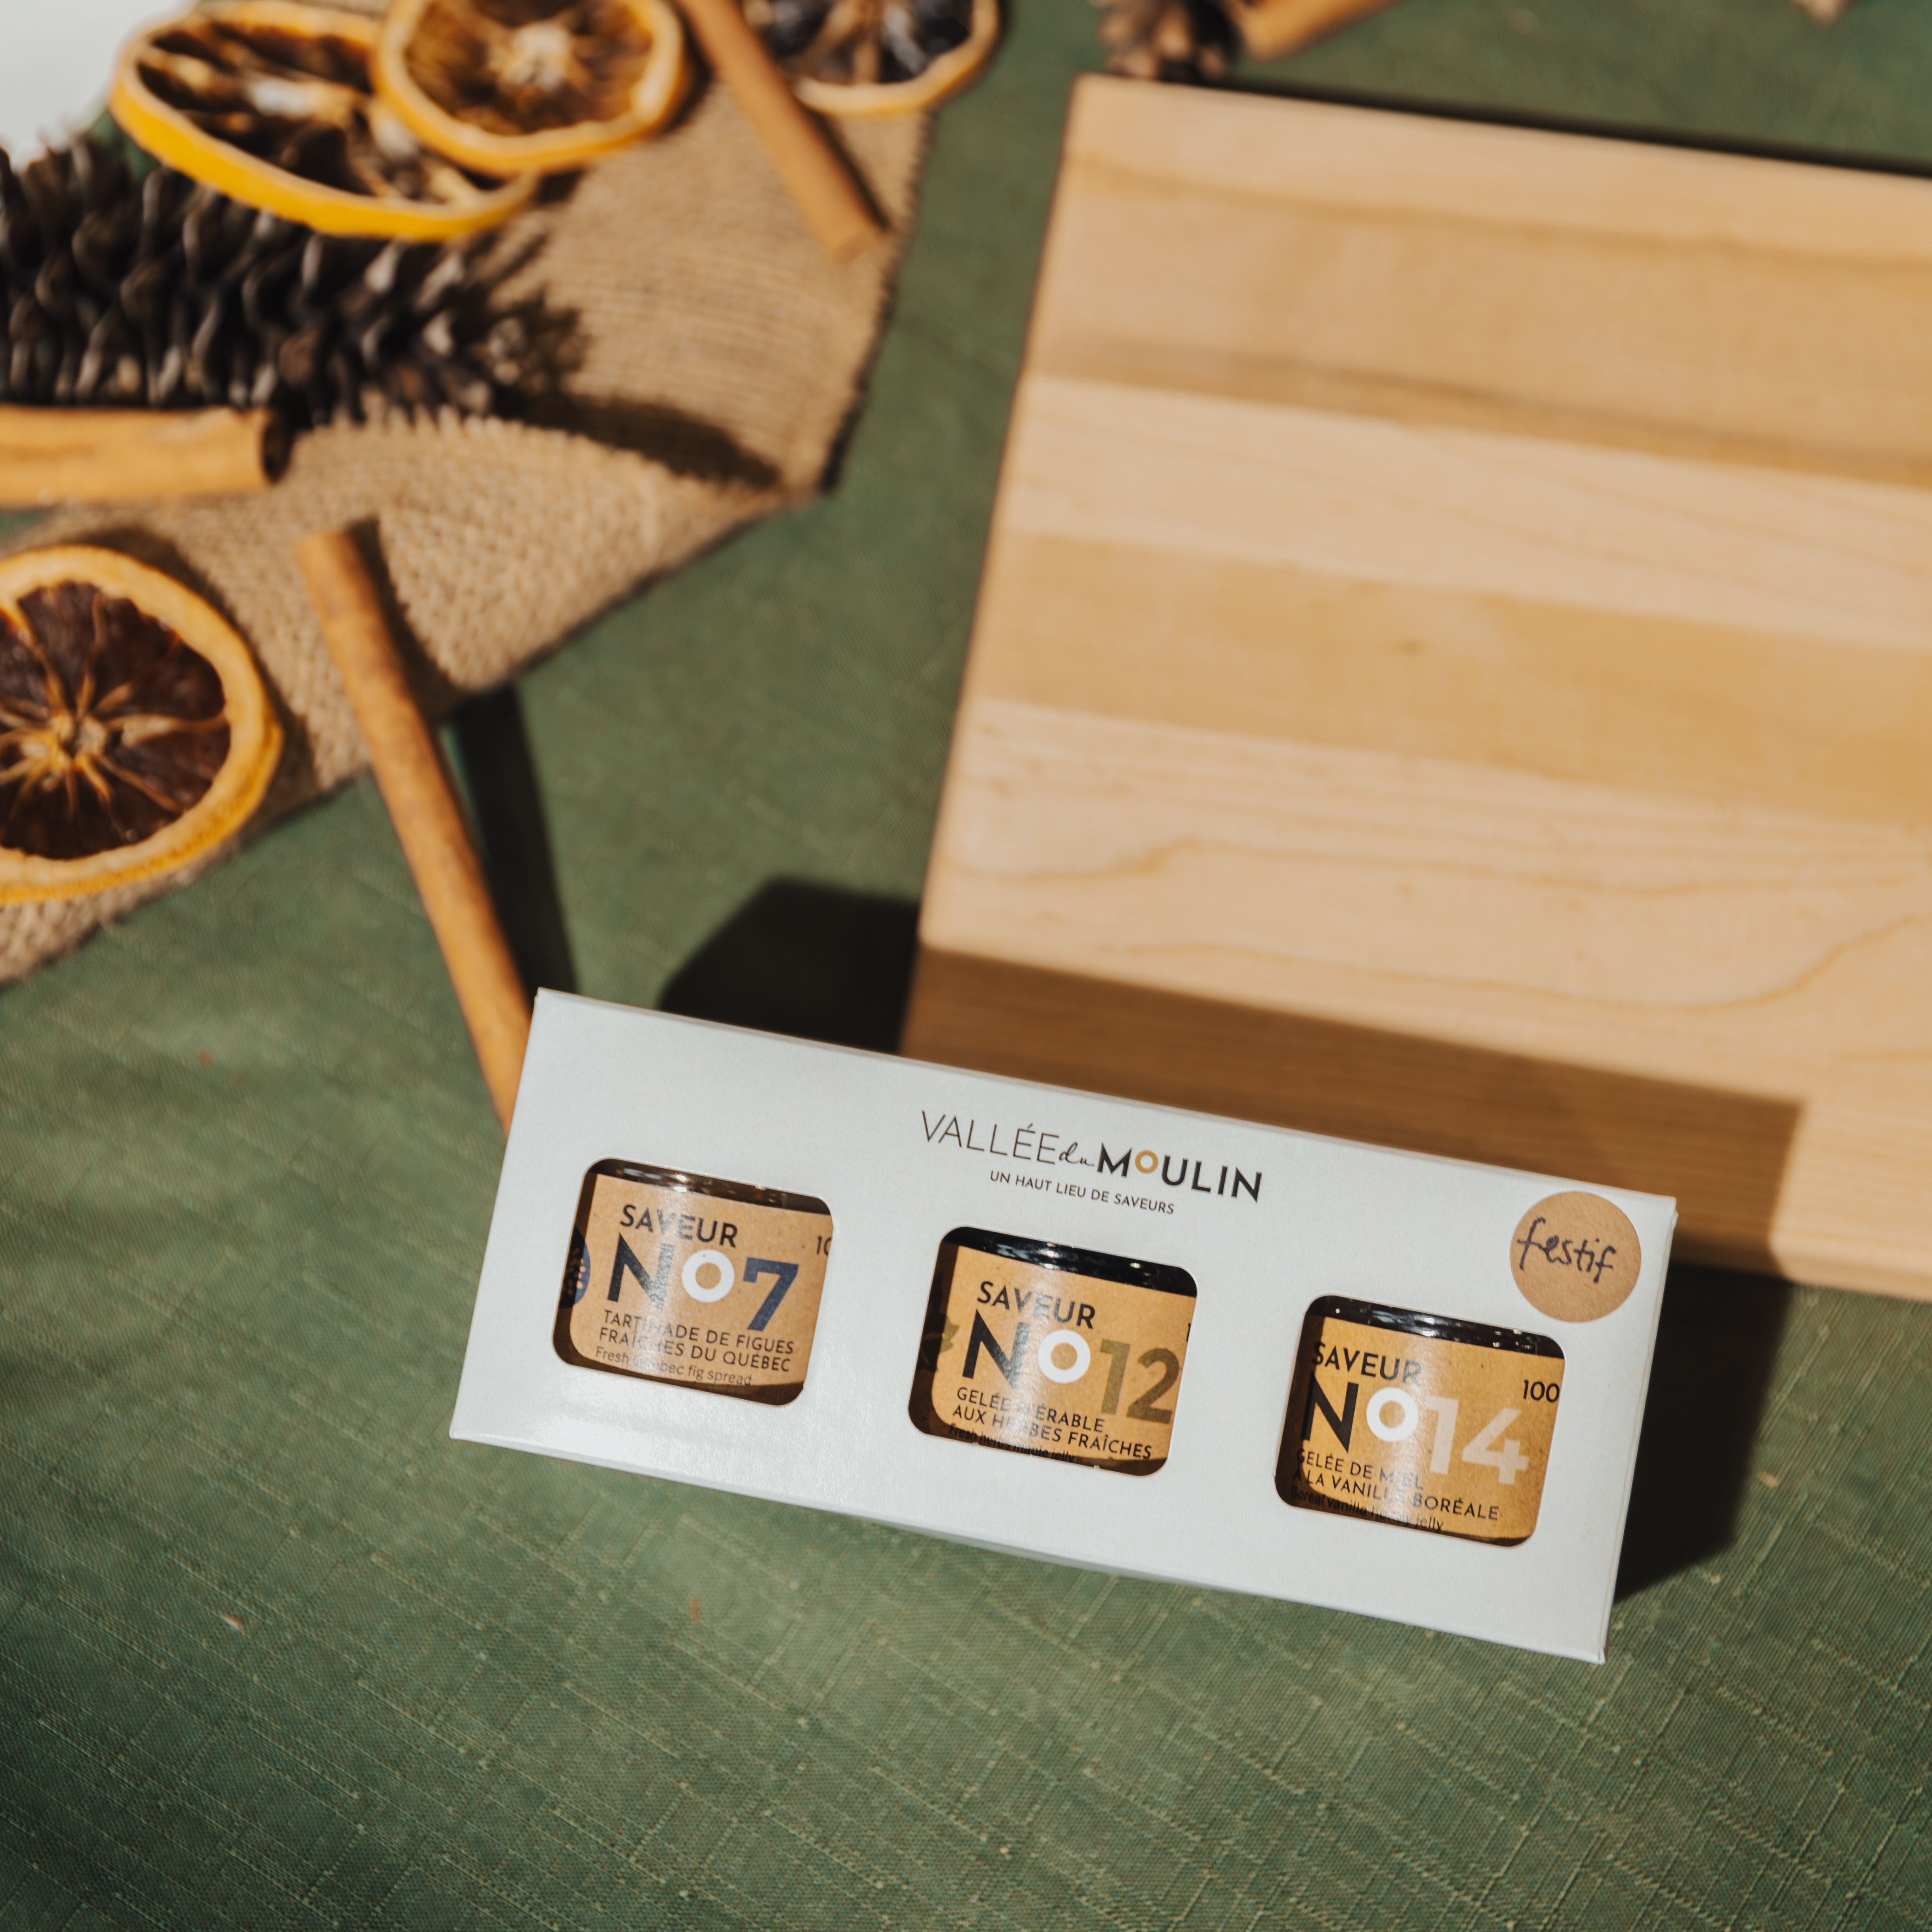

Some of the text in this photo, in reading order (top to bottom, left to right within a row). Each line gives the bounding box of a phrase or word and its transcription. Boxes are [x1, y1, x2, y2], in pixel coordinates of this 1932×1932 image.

[922, 1110, 1263, 1203] VALLÉE du MOULIN
[990, 1170, 1175, 1215] UN HAUT LIEU DE SAVEURS
[620, 1204, 739, 1248] SAVEUR
[1517, 1217, 1617, 1284] festif
[977, 1280, 1097, 1330] SAVEUR
[604, 1310, 794, 1355] TARTINADE DE FIGUES
[596, 1346, 629, 1363] Fresh
[688, 1364, 704, 1381] fig
[707, 1370, 752, 1386] spread
[691, 1345, 716, 1362] DU
[723, 1350, 791, 1372] QUÉBEC
[1311, 1341, 1422, 1387] SAVEUR
[957, 1387, 1011, 1412] GELÉE
[1523, 1379, 1560, 1403] 100
[953, 1404, 1152, 1460] AUX HERBES FRAÎCHES
[1297, 1448, 1423, 1491] GELÉE DE MIEL
[1306, 1469, 1324, 1487] LA
[1331, 1475, 1405, 1506] VANILLE
[1412, 1493, 1499, 1521] BORÉALE
